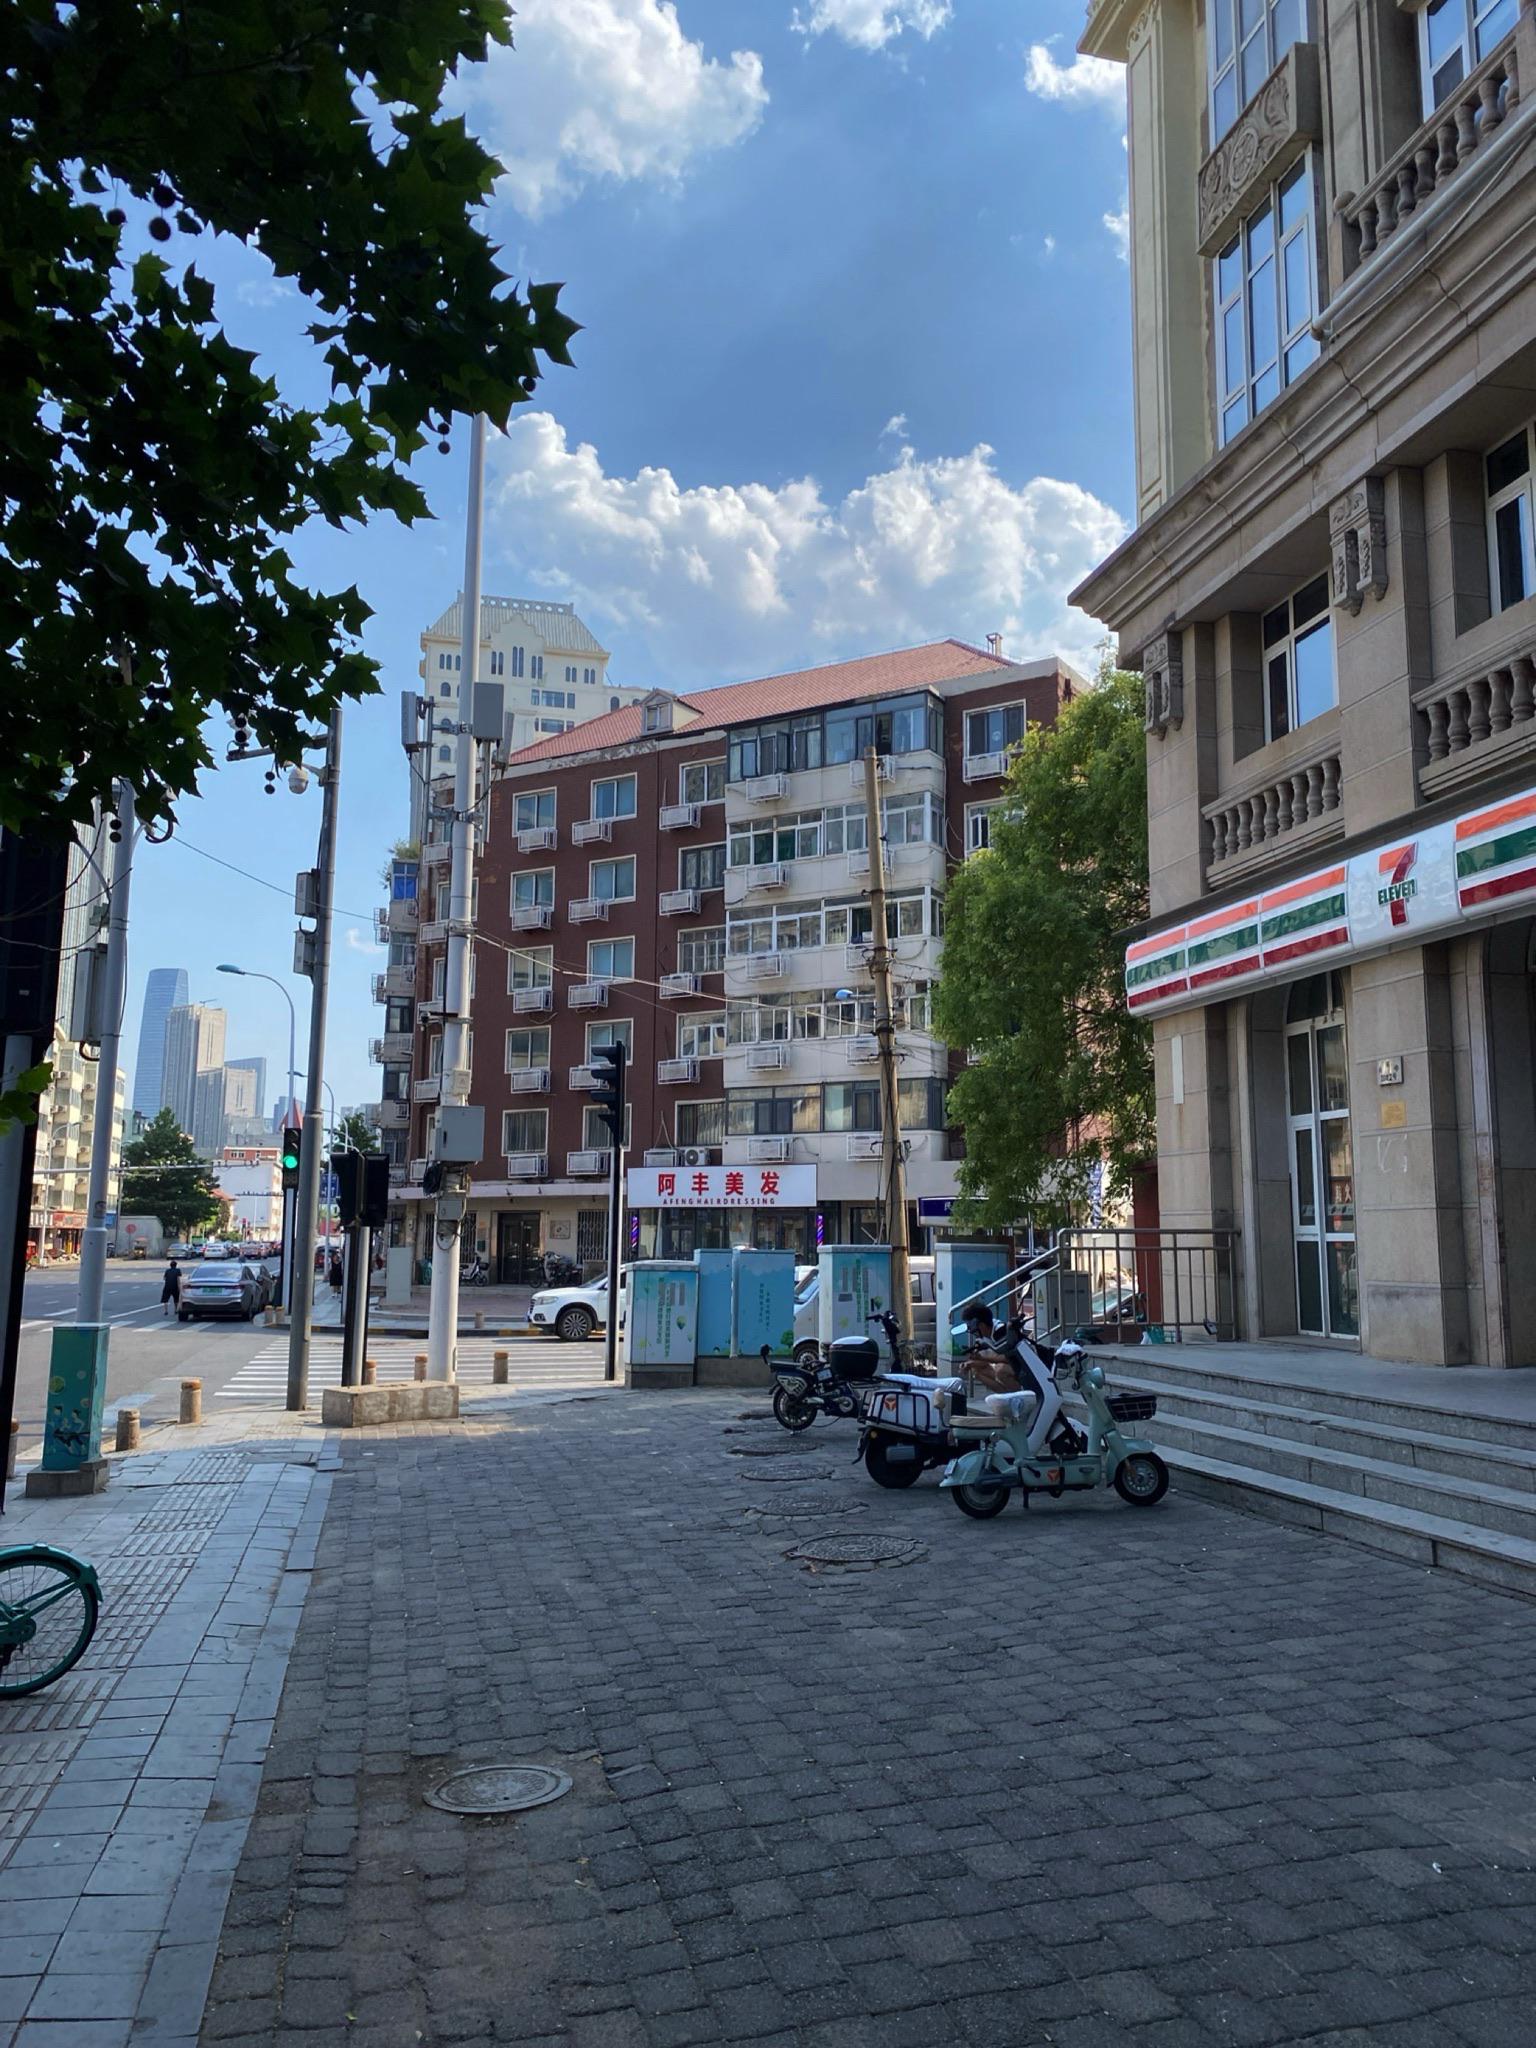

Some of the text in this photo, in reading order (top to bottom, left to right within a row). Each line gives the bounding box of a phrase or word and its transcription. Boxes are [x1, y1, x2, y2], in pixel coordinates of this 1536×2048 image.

[1378, 842, 1417, 926] 7
[658, 1171, 780, 1197] 阿丰美发
